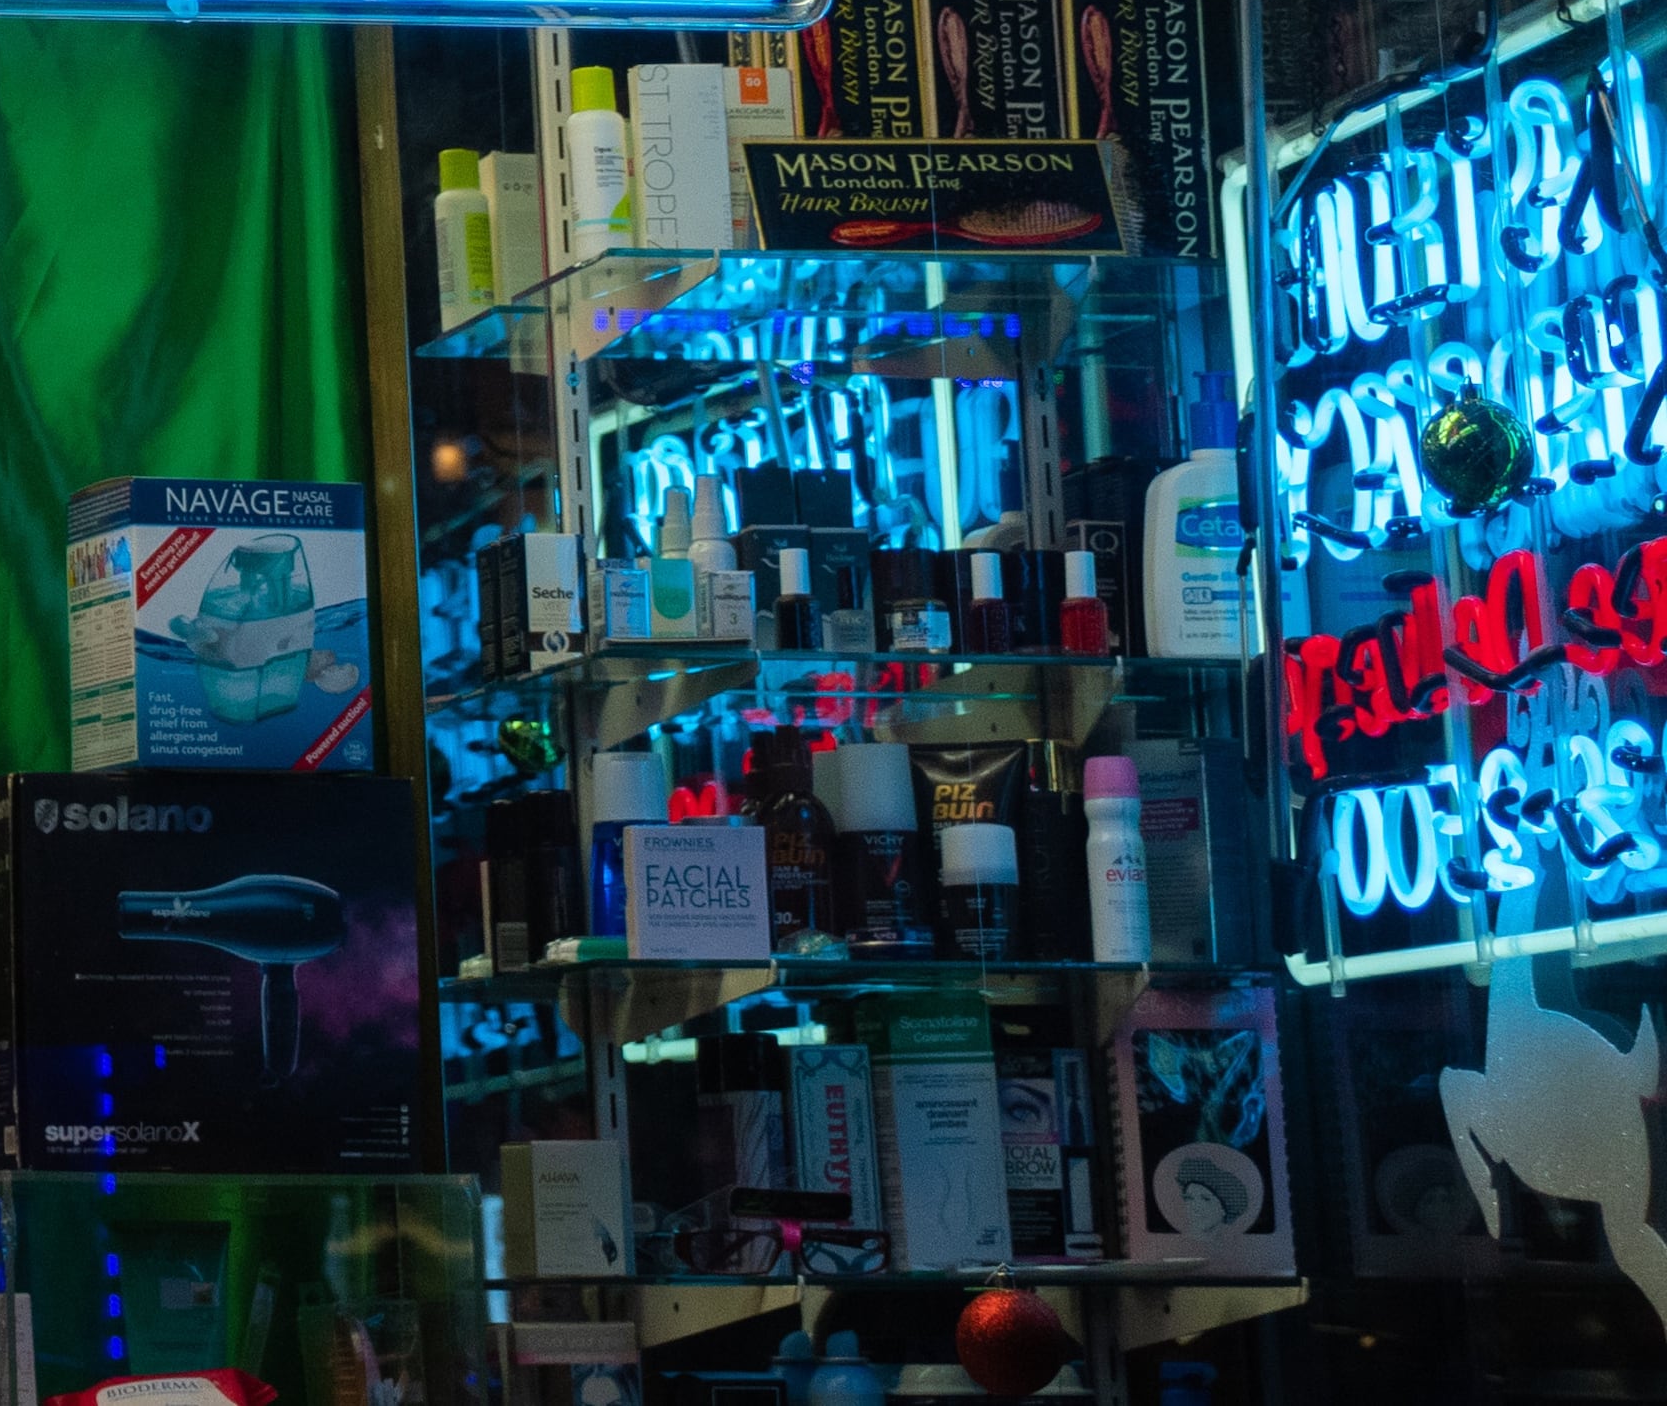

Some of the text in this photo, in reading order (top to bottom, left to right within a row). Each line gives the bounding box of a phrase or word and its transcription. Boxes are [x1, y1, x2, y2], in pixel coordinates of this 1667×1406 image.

[1115, 25, 1141, 106] BRUSH
[775, 151, 1074, 191] MASON PEARSON
[1158, 97, 1201, 258] PEARSON
[779, 191, 929, 215] HAIR BRUSH
[165, 482, 291, 516] NAVÄGE
[292, 491, 331, 504] NASAL
[292, 504, 334, 518] CARE
[532, 588, 575, 600] Seche
[148, 705, 203, 718] drug-free
[149, 718, 208, 729] relief from
[149, 731, 218, 744] allergies and
[150, 744, 244, 758] sinus congestion!
[933, 785, 977, 802] PIZ
[62, 797, 213, 833] solano
[932, 801, 994, 821] BUIN
[862, 834, 905, 846] VICHY
[645, 865, 750, 889] FACIAL
[646, 888, 752, 909] PATCHES
[44, 1120, 201, 1146] supersolanoX
[1006, 1160, 1057, 1175] BROW
